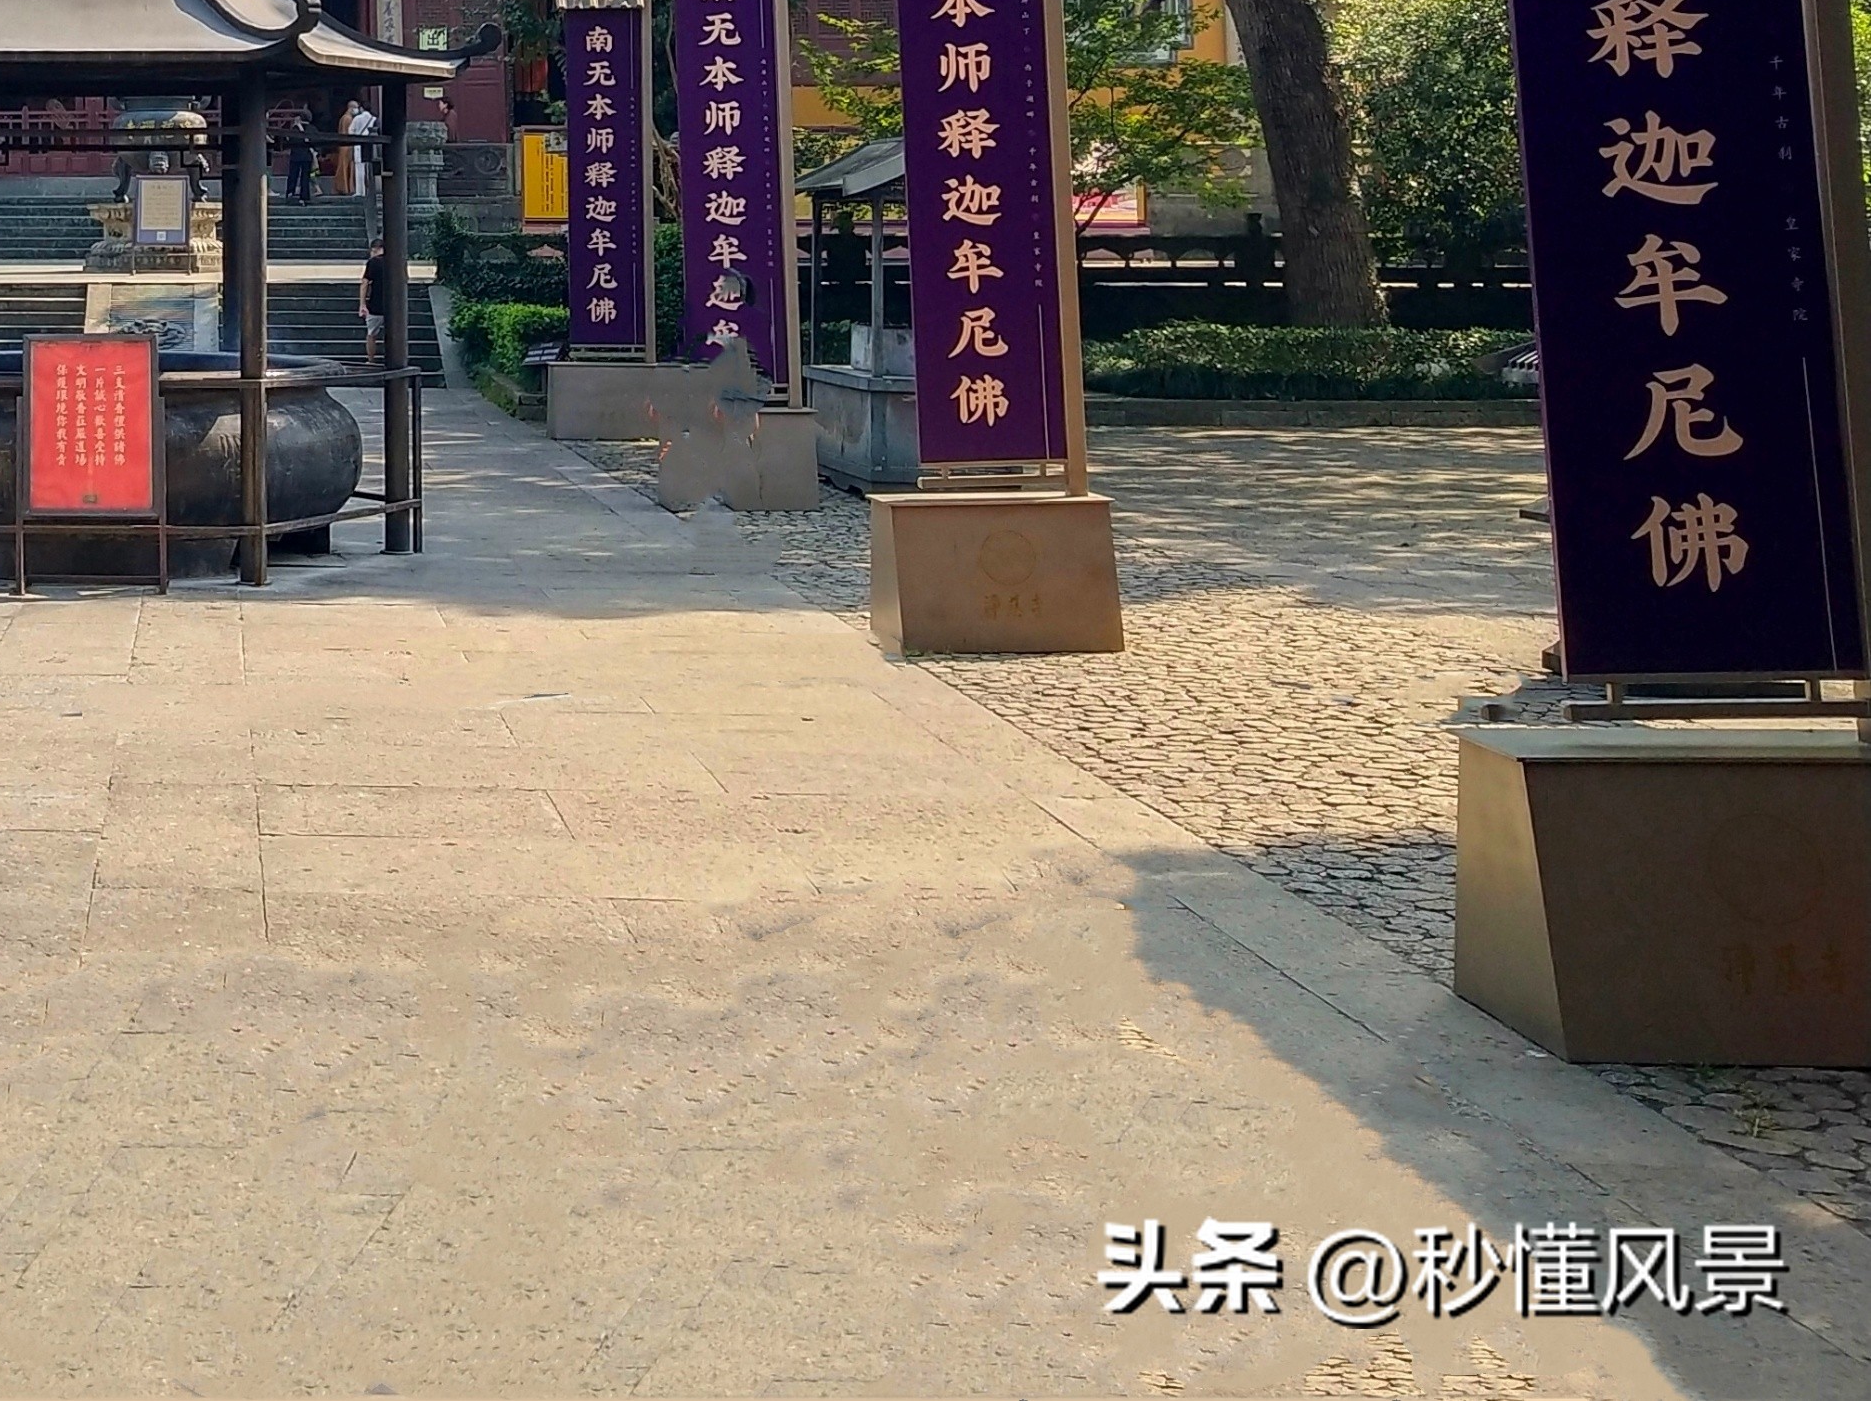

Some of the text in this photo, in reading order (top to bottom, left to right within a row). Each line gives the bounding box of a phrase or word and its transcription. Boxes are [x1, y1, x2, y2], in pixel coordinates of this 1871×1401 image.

[583, 25, 619, 325] 南无本师释迦牟尼佛
